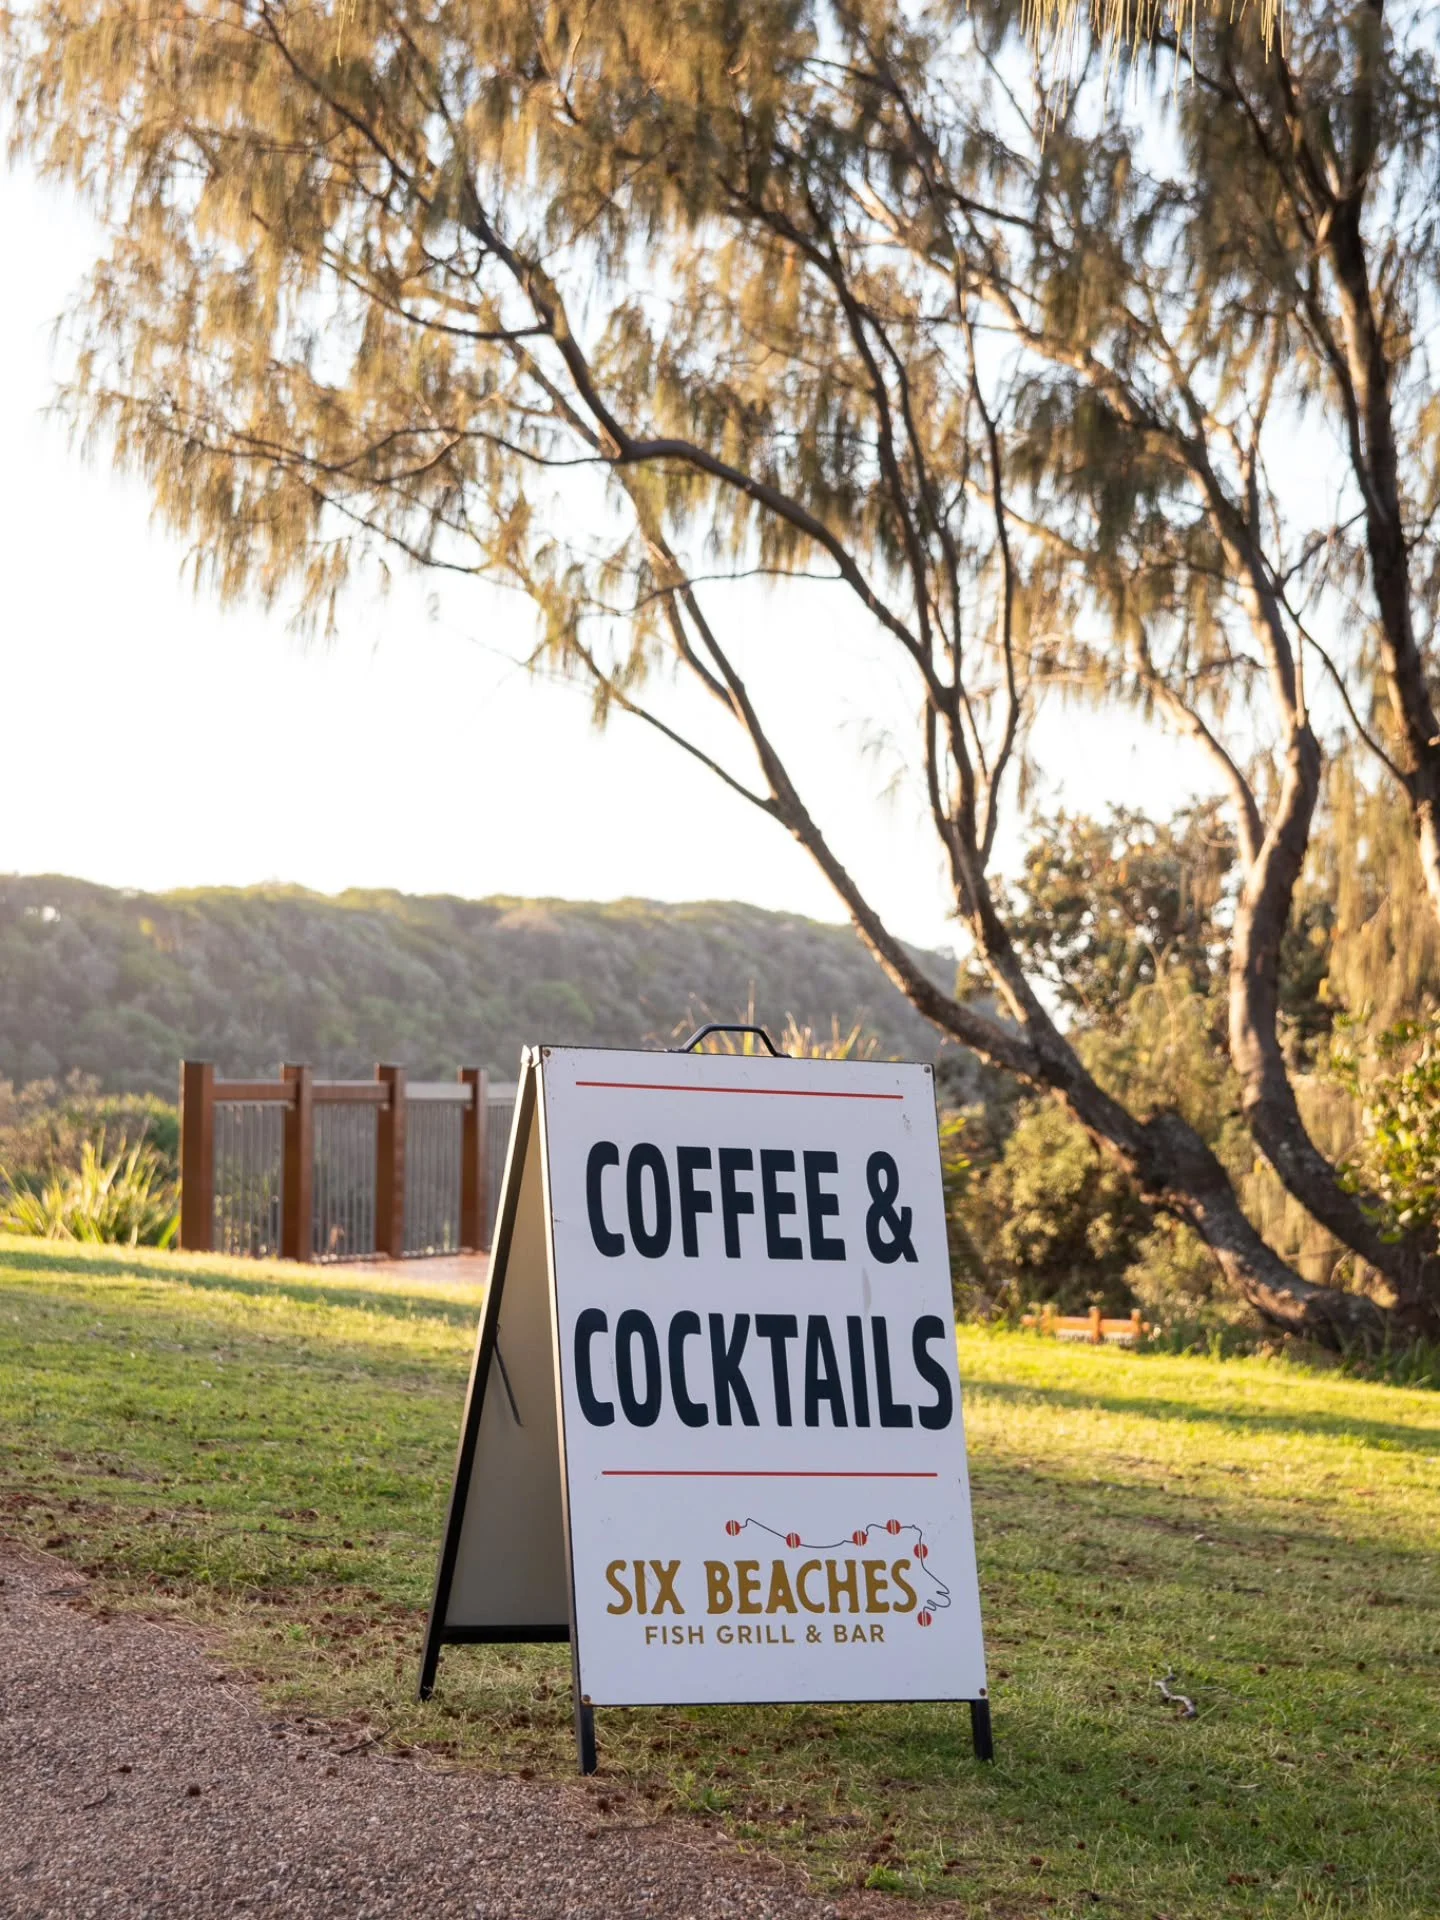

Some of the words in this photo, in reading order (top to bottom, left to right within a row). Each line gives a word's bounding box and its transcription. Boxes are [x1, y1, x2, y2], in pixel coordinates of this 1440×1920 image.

[587, 1141, 846, 1261] COFFEE
[866, 1151, 918, 1264] &
[574, 1307, 953, 1430] COCKTAILS
[605, 1559, 686, 1615] SIX
[704, 1559, 918, 1615] BEACHES
[645, 1625, 704, 1645] FISH
[717, 1625, 794, 1644] GRILL
[806, 1625, 822, 1643] &
[834, 1624, 885, 1643] BAR
